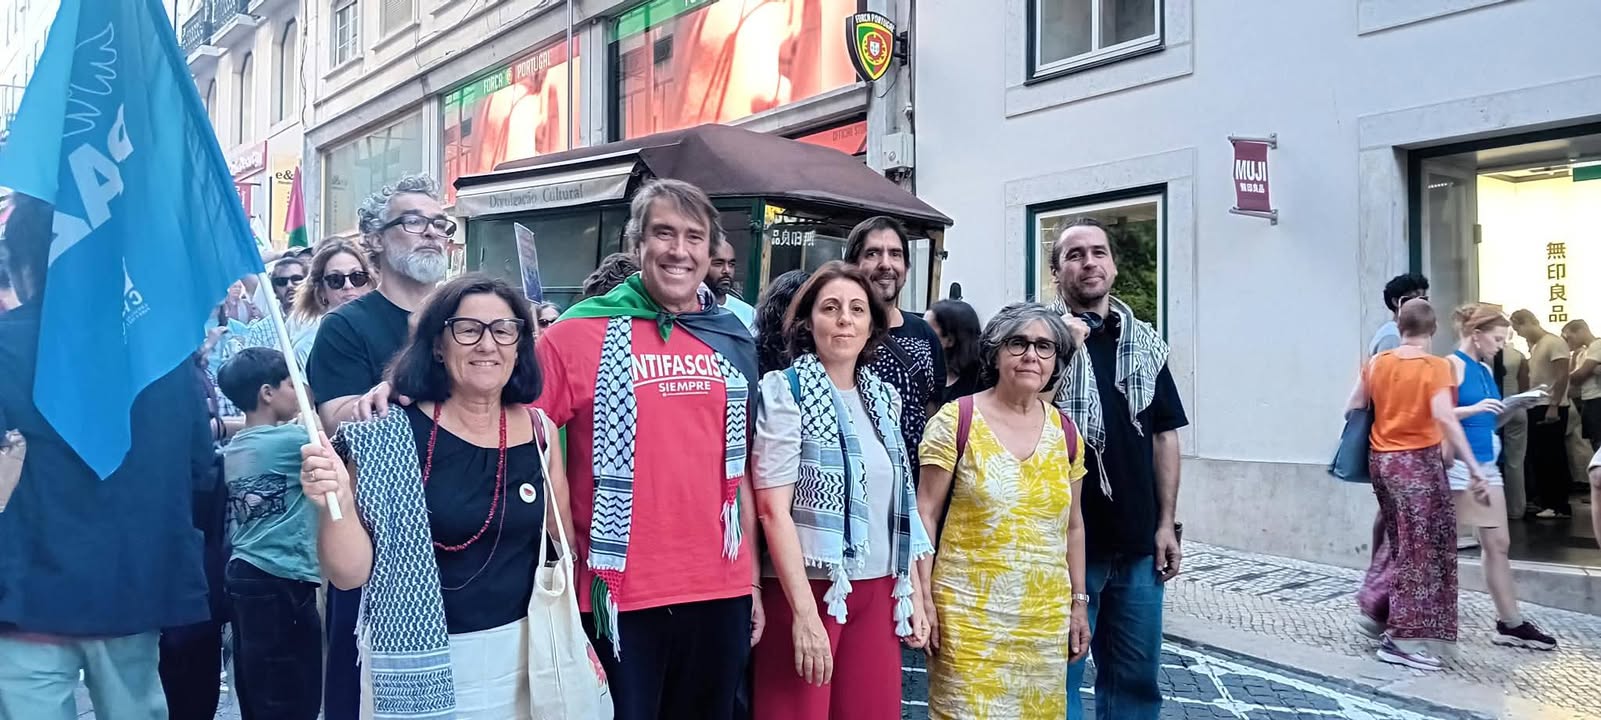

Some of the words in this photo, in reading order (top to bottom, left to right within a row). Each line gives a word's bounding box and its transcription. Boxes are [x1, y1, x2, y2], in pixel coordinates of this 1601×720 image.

[517, 50, 551, 78] PORTUGAL
[1235, 159, 1267, 182] MUJI
[542, 183, 583, 202] Cultural
[1546, 242, 1568, 322] 無印良品
[630, 353, 722, 382] NTIFASCIS
[658, 381, 711, 393] SIEMPRE
